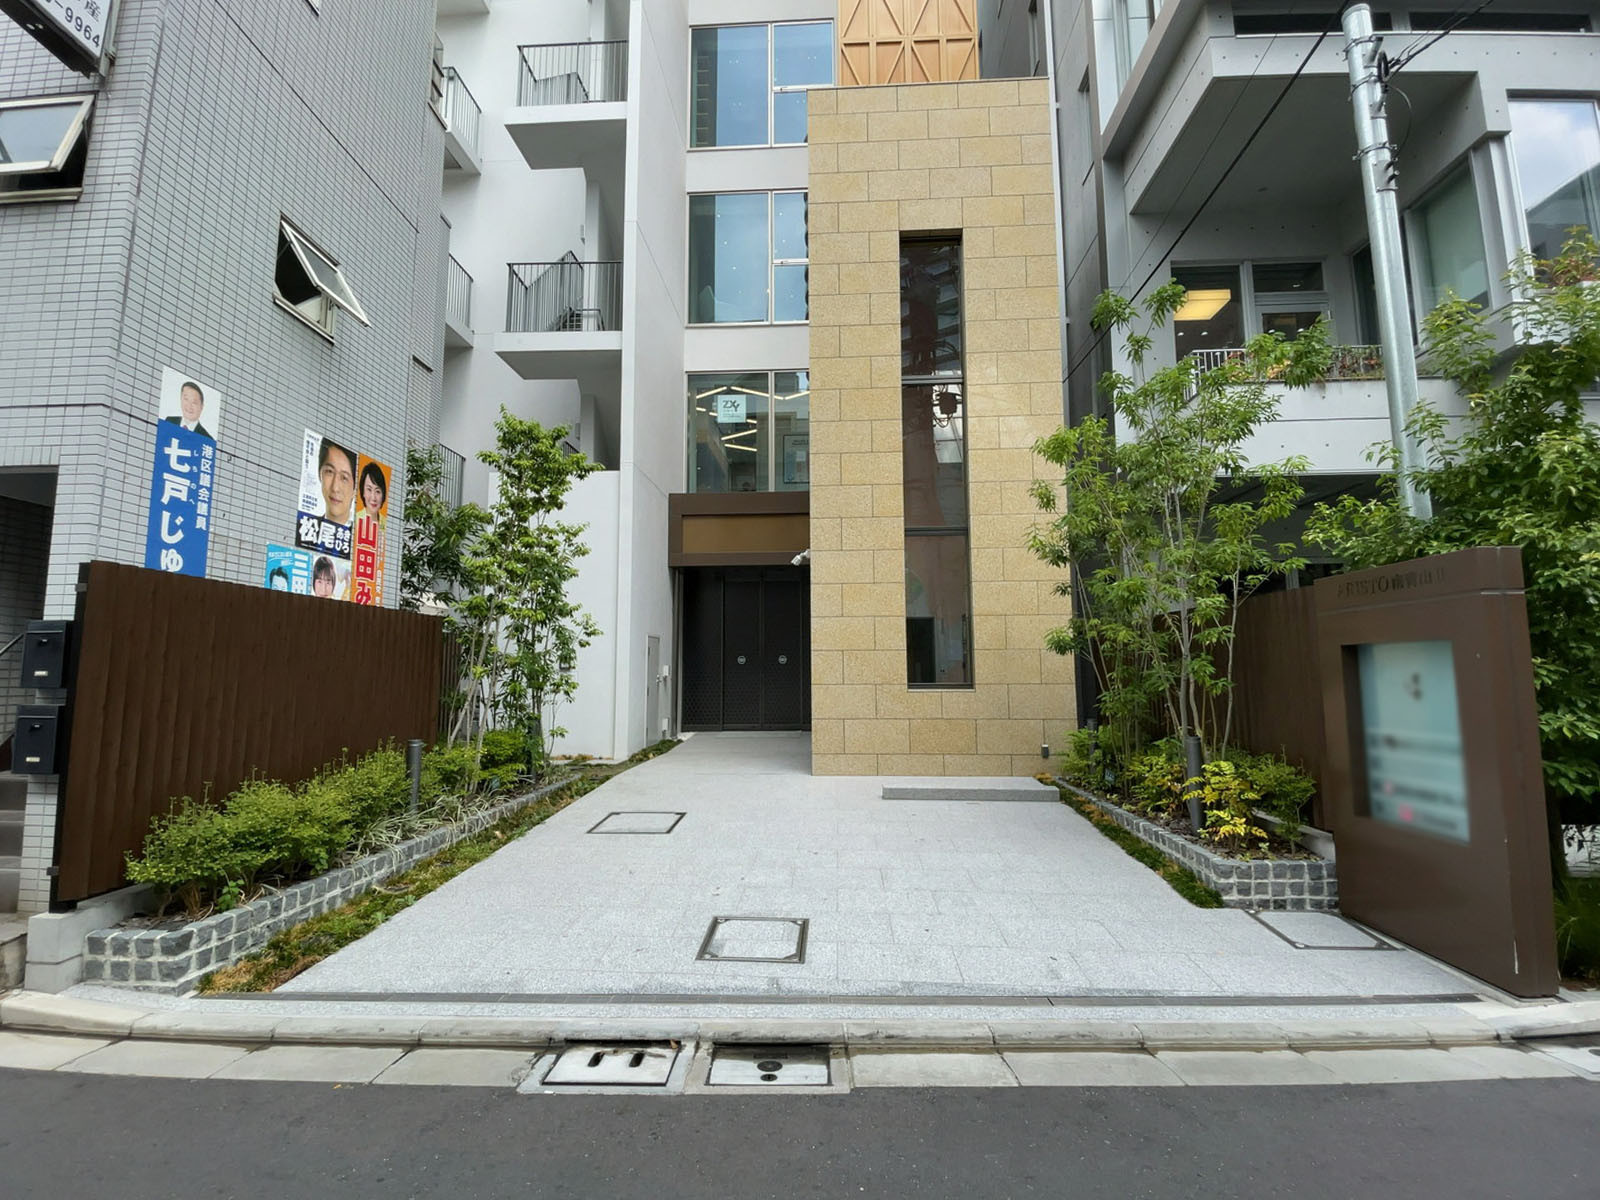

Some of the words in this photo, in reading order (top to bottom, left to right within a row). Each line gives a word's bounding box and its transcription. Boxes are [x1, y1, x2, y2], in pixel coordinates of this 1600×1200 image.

[45, 0, 100, 48] -9964
[195, 443, 214, 531] 港区議会議員
[299, 515, 336, 549] 松尾
